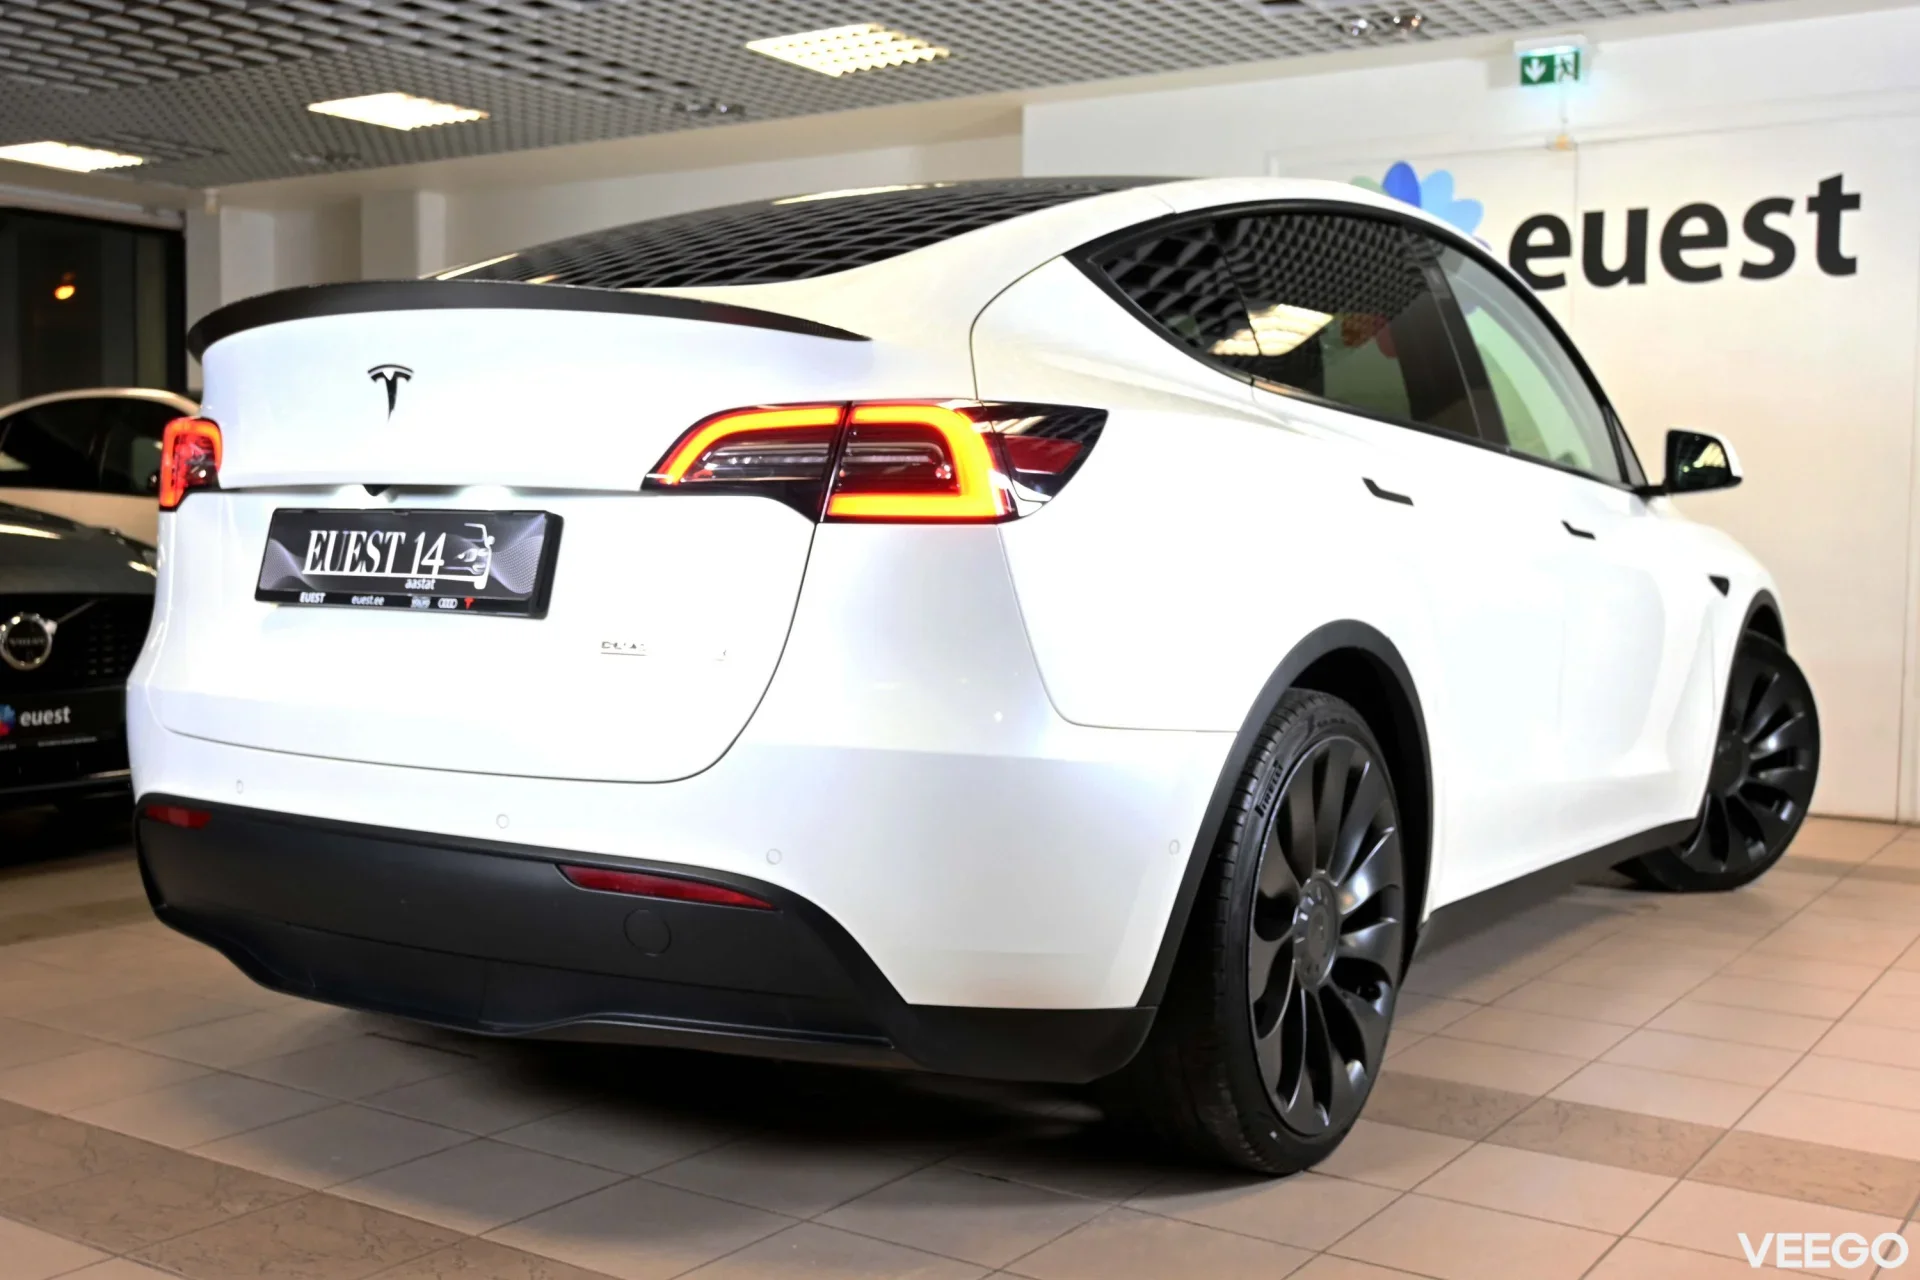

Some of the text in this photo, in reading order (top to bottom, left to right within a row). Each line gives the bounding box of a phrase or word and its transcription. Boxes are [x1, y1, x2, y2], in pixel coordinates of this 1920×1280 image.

[1508, 173, 1862, 291] euest
[302, 529, 446, 576] EUEST 14
[404, 577, 436, 590] aastat
[300, 591, 326, 604] EUEST
[351, 594, 385, 606] euest.ee
[20, 705, 71, 726] euest
